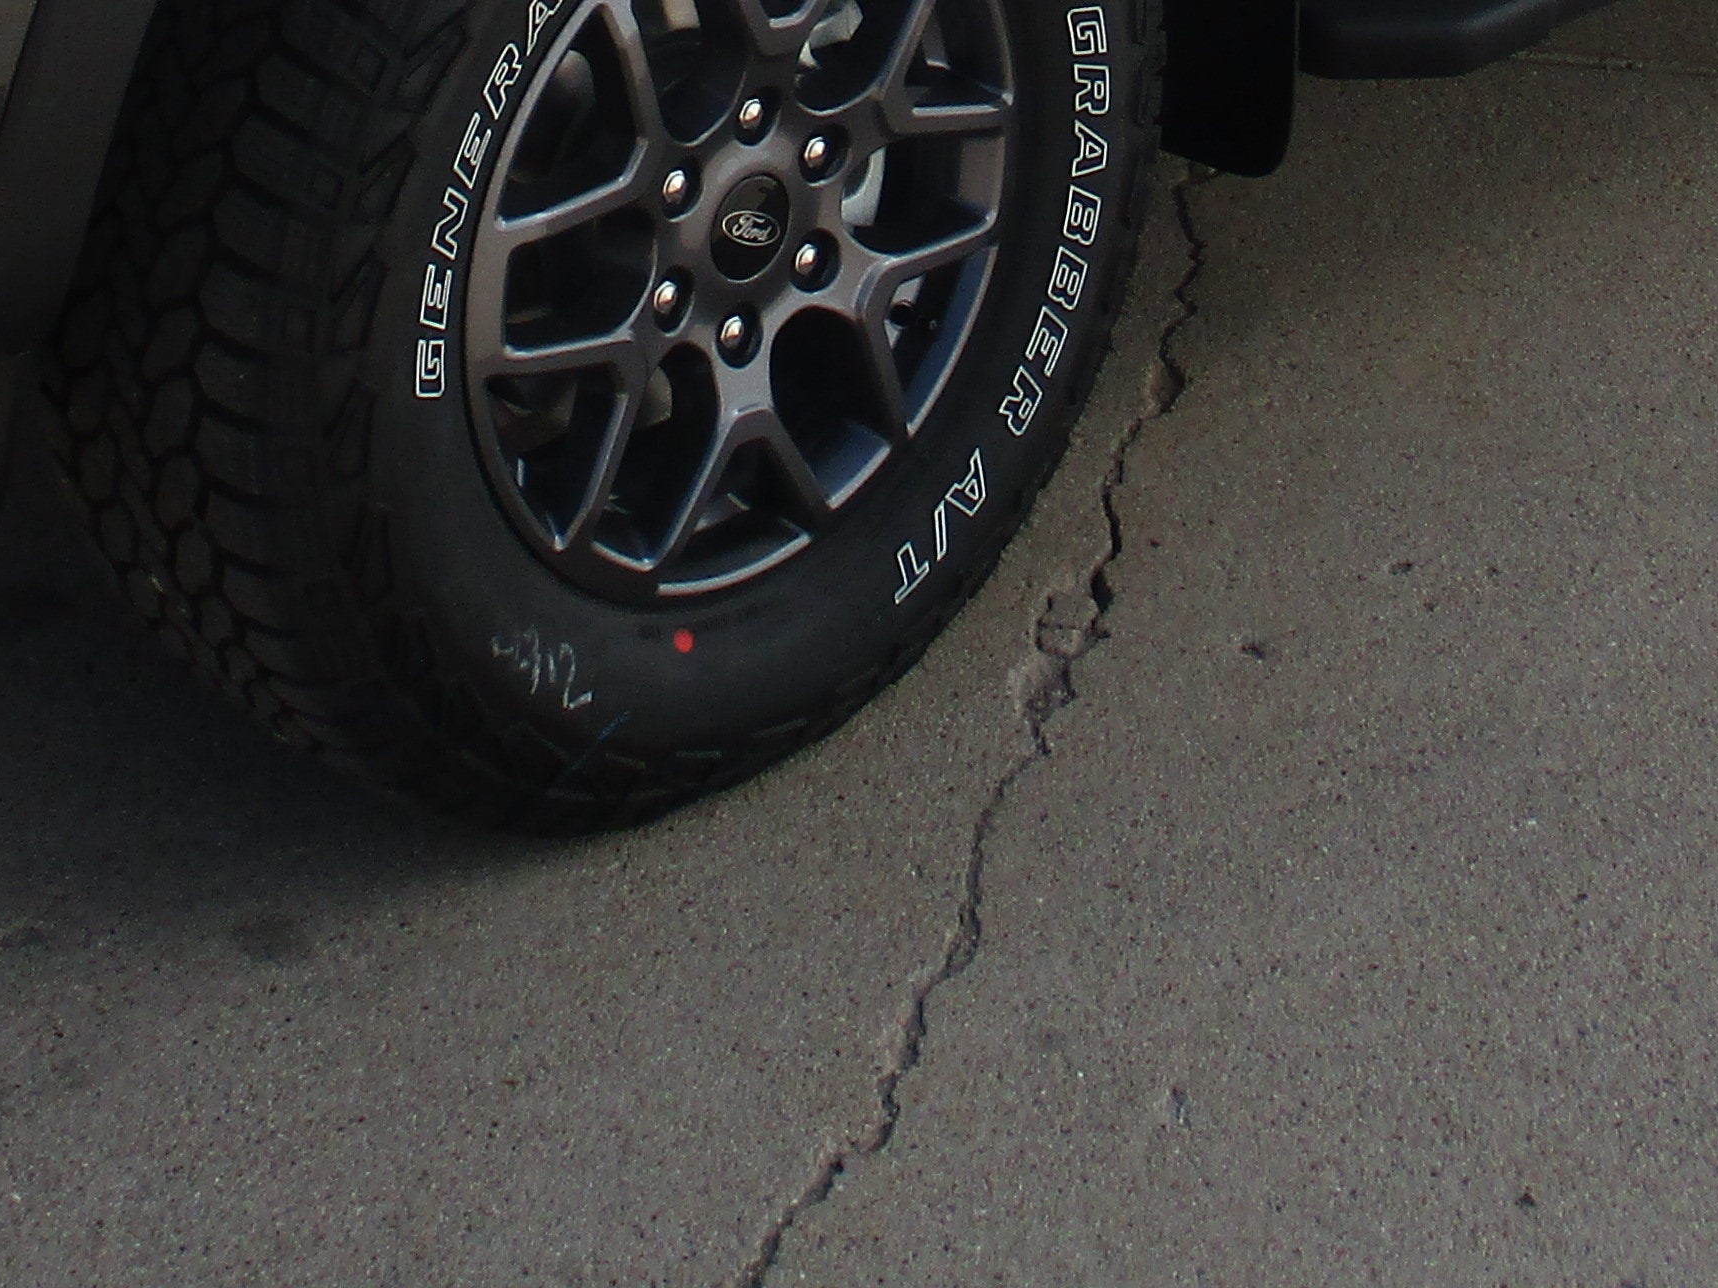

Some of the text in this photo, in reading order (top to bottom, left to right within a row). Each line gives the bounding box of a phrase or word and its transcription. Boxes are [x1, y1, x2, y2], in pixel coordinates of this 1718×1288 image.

[731, 213, 773, 242] Ford
[894, 4, 1111, 605] GRABBER A/T
